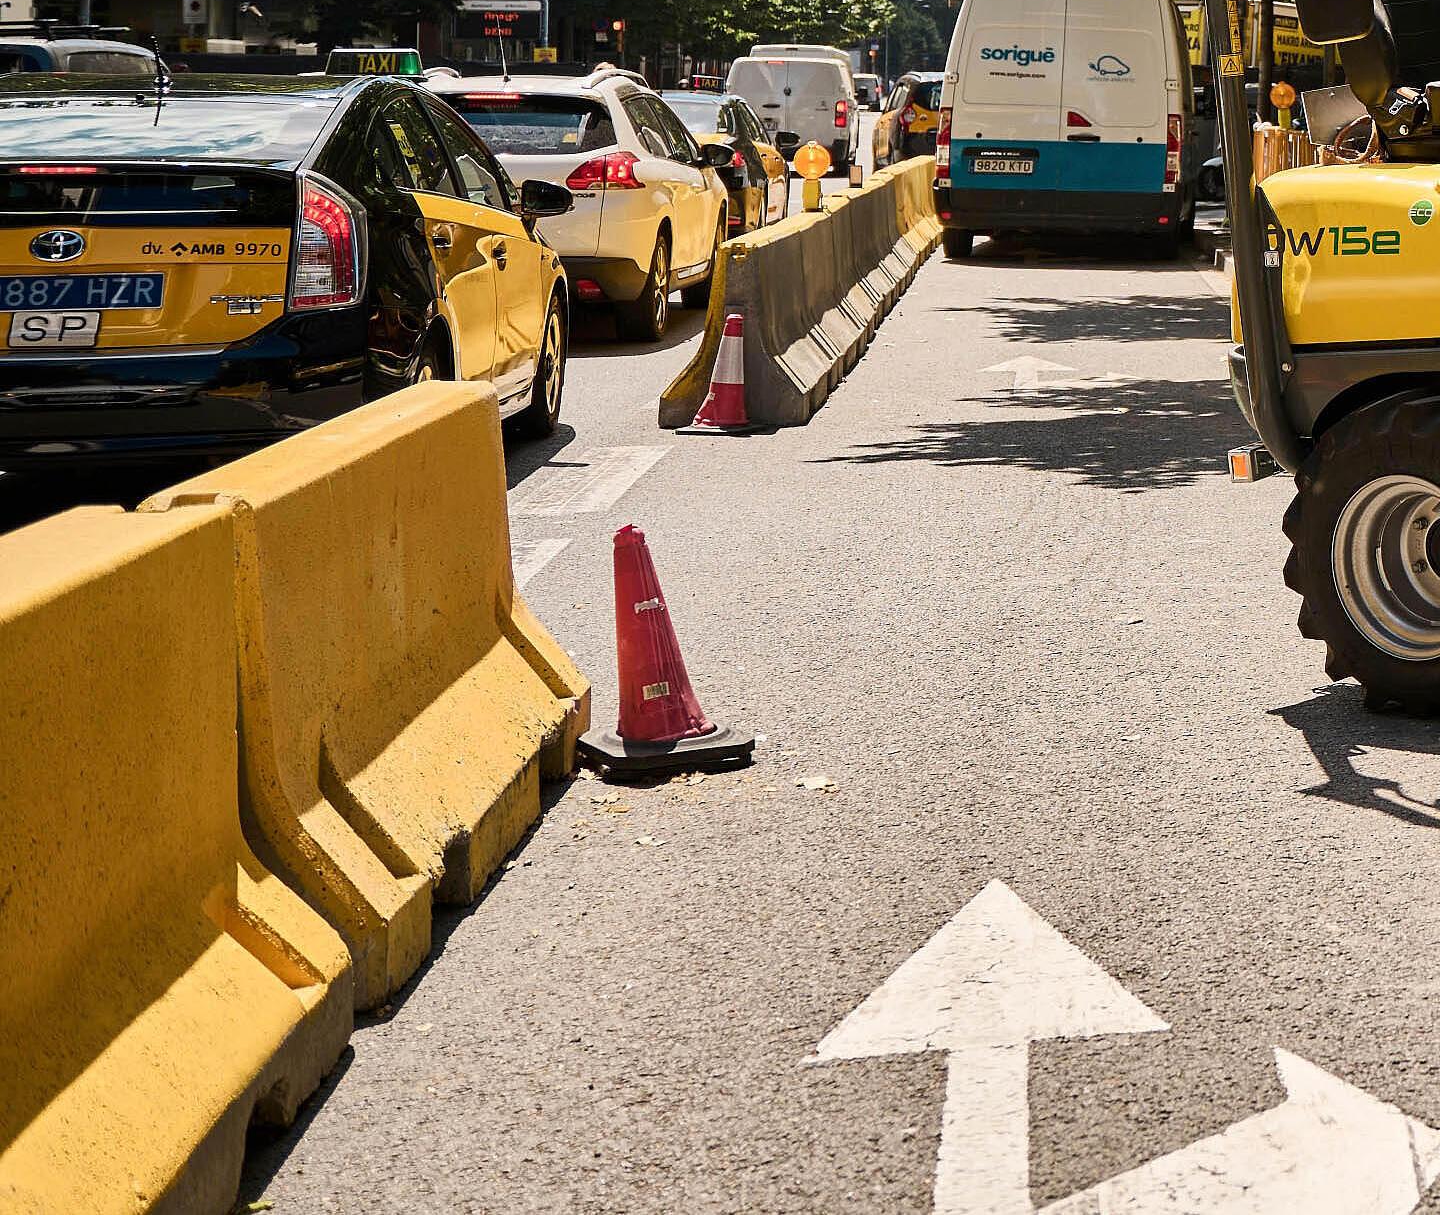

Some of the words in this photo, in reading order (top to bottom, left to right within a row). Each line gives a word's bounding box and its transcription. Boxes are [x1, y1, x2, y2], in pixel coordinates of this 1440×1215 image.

[357, 53, 398, 74] TAXI
[702, 79, 719, 88] TAXI
[976, 160, 1006, 172] 9820
[1009, 161, 1031, 172] KTD
[1408, 207, 1432, 218] ECO
[142, 242, 163, 255] dv.
[190, 244, 225, 256] AMB
[235, 242, 282, 257] 9970
[86, 277, 155, 305] HZR
